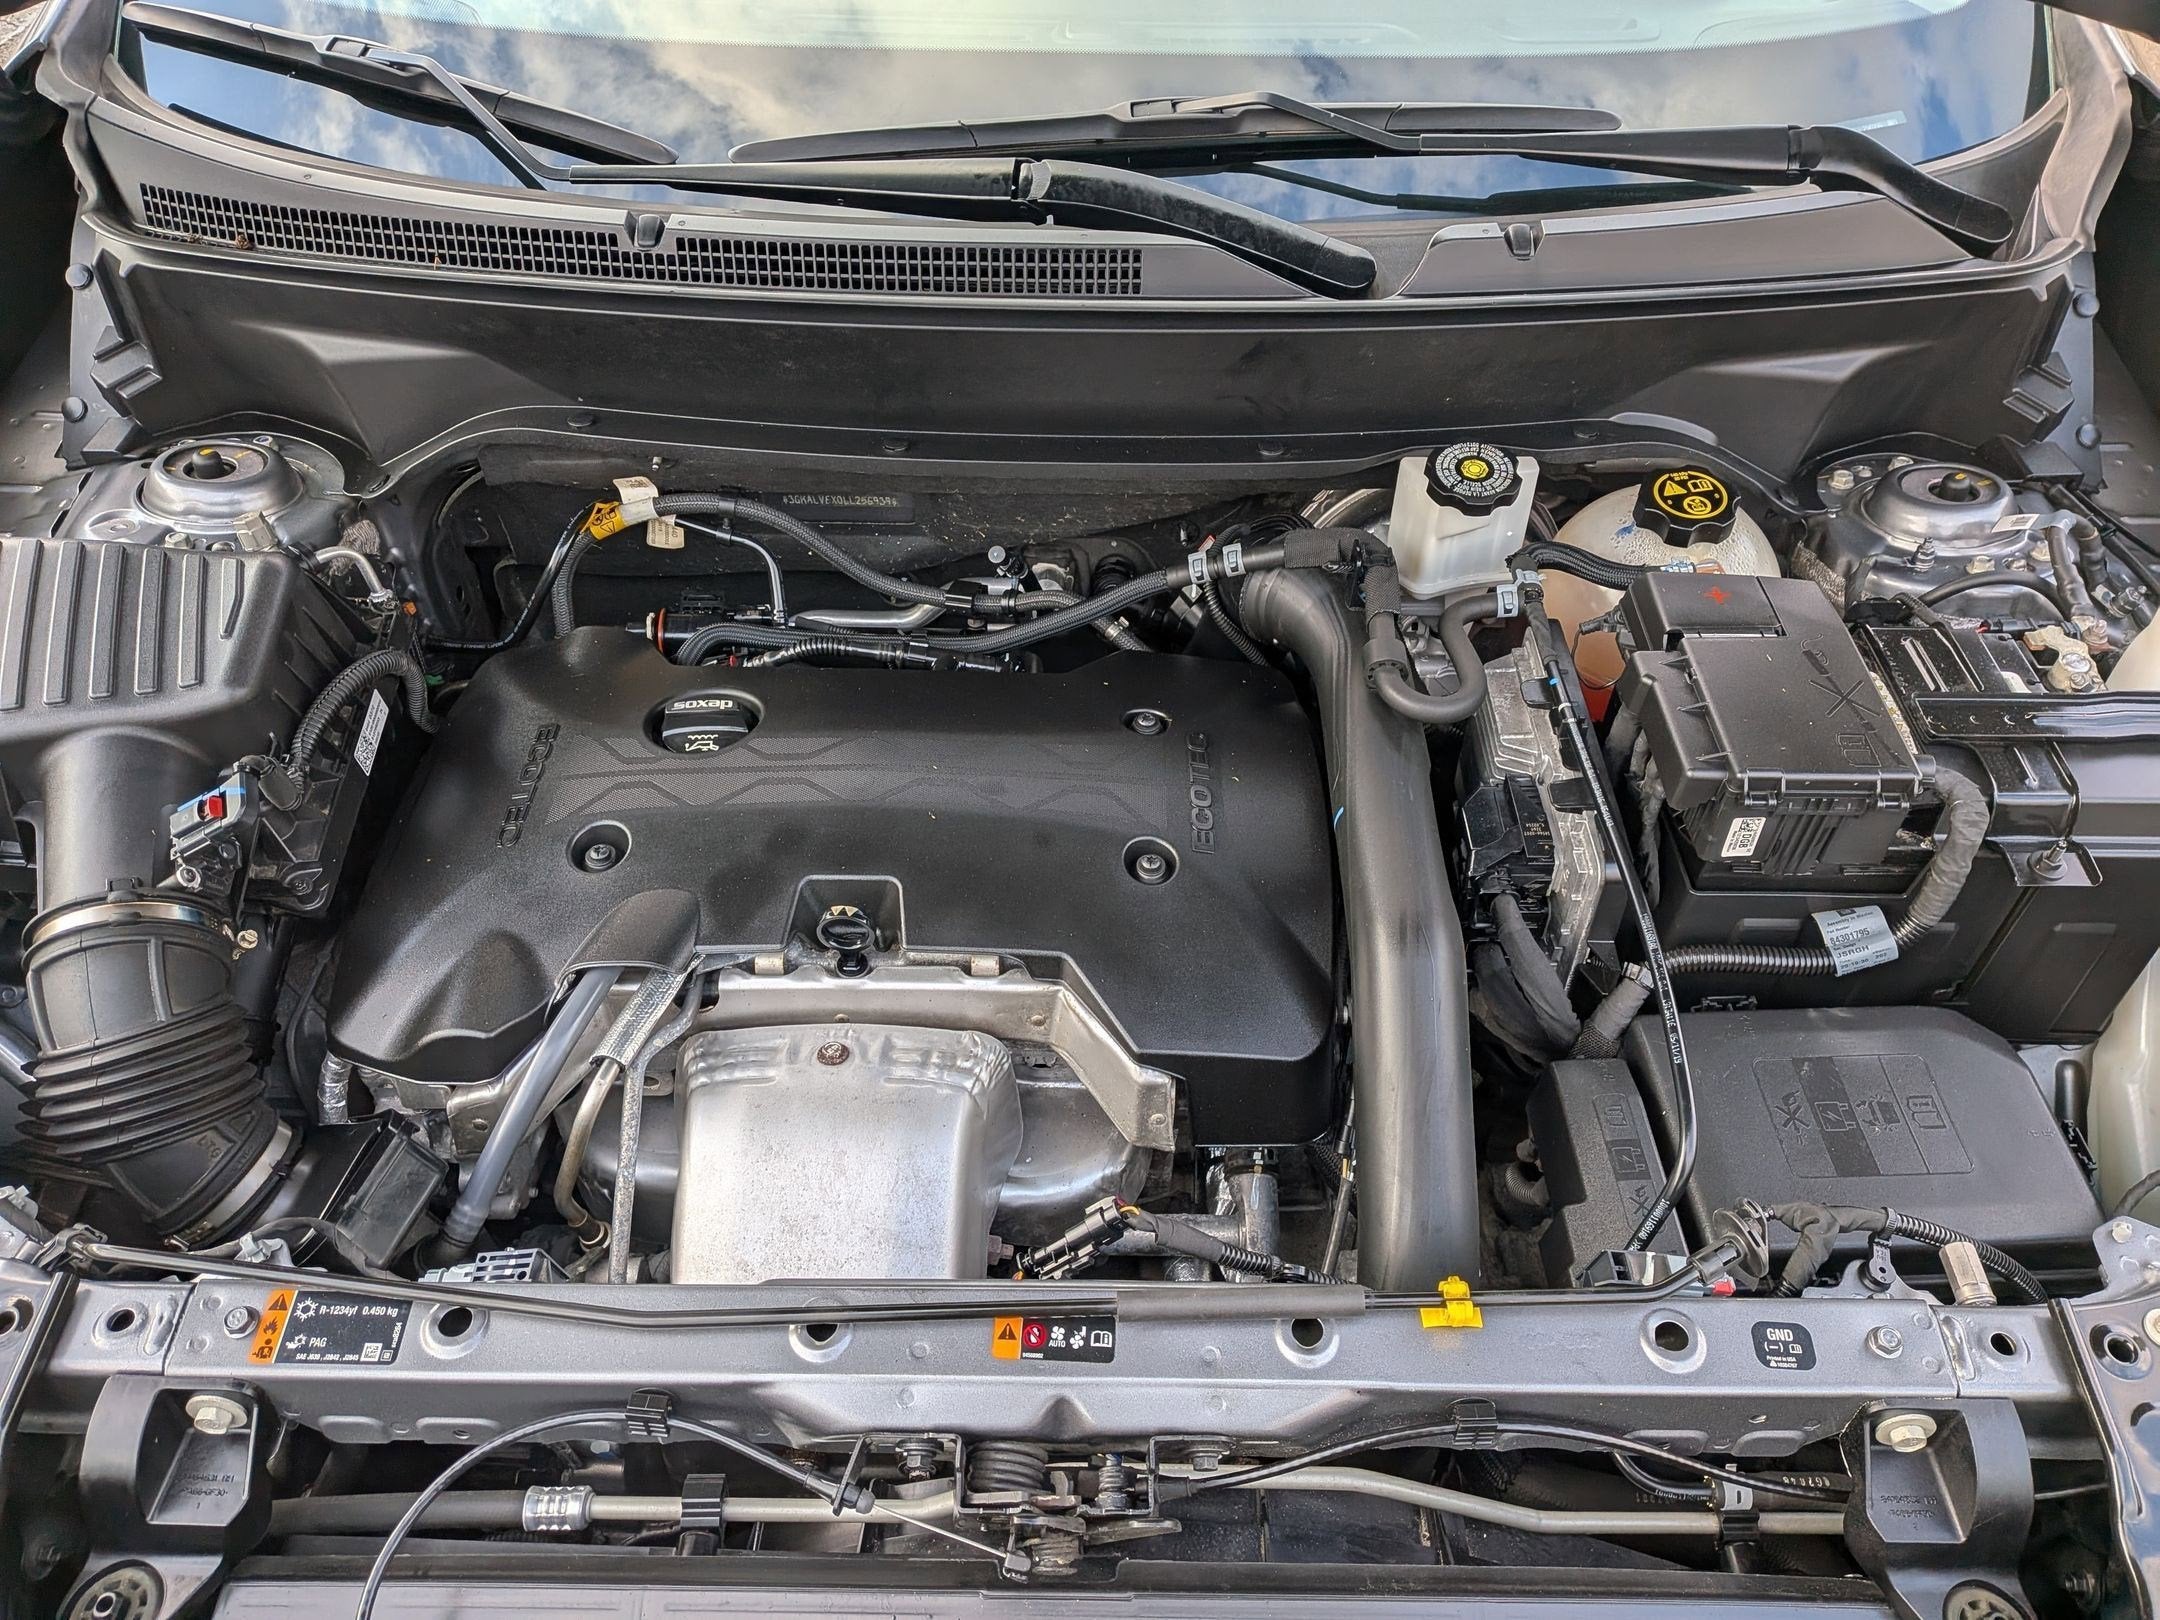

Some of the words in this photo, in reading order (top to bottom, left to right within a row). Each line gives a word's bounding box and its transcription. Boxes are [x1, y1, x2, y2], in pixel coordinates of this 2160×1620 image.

[497, 723, 560, 847] ECOTEC
[1187, 733, 1215, 853] ECOTEC
[1738, 833, 1752, 849] DGB
[1829, 927, 1870, 945] 84301795
[320, 1305, 359, 1316] R-1234yf
[362, 1306, 384, 1316] 0.450
[387, 1306, 399, 1317] kg
[1766, 1328, 1793, 1341] GND
[308, 1337, 328, 1348] PAG
[1048, 1339, 1066, 1348] AUTO
[295, 1352, 306, 1361] SAE
